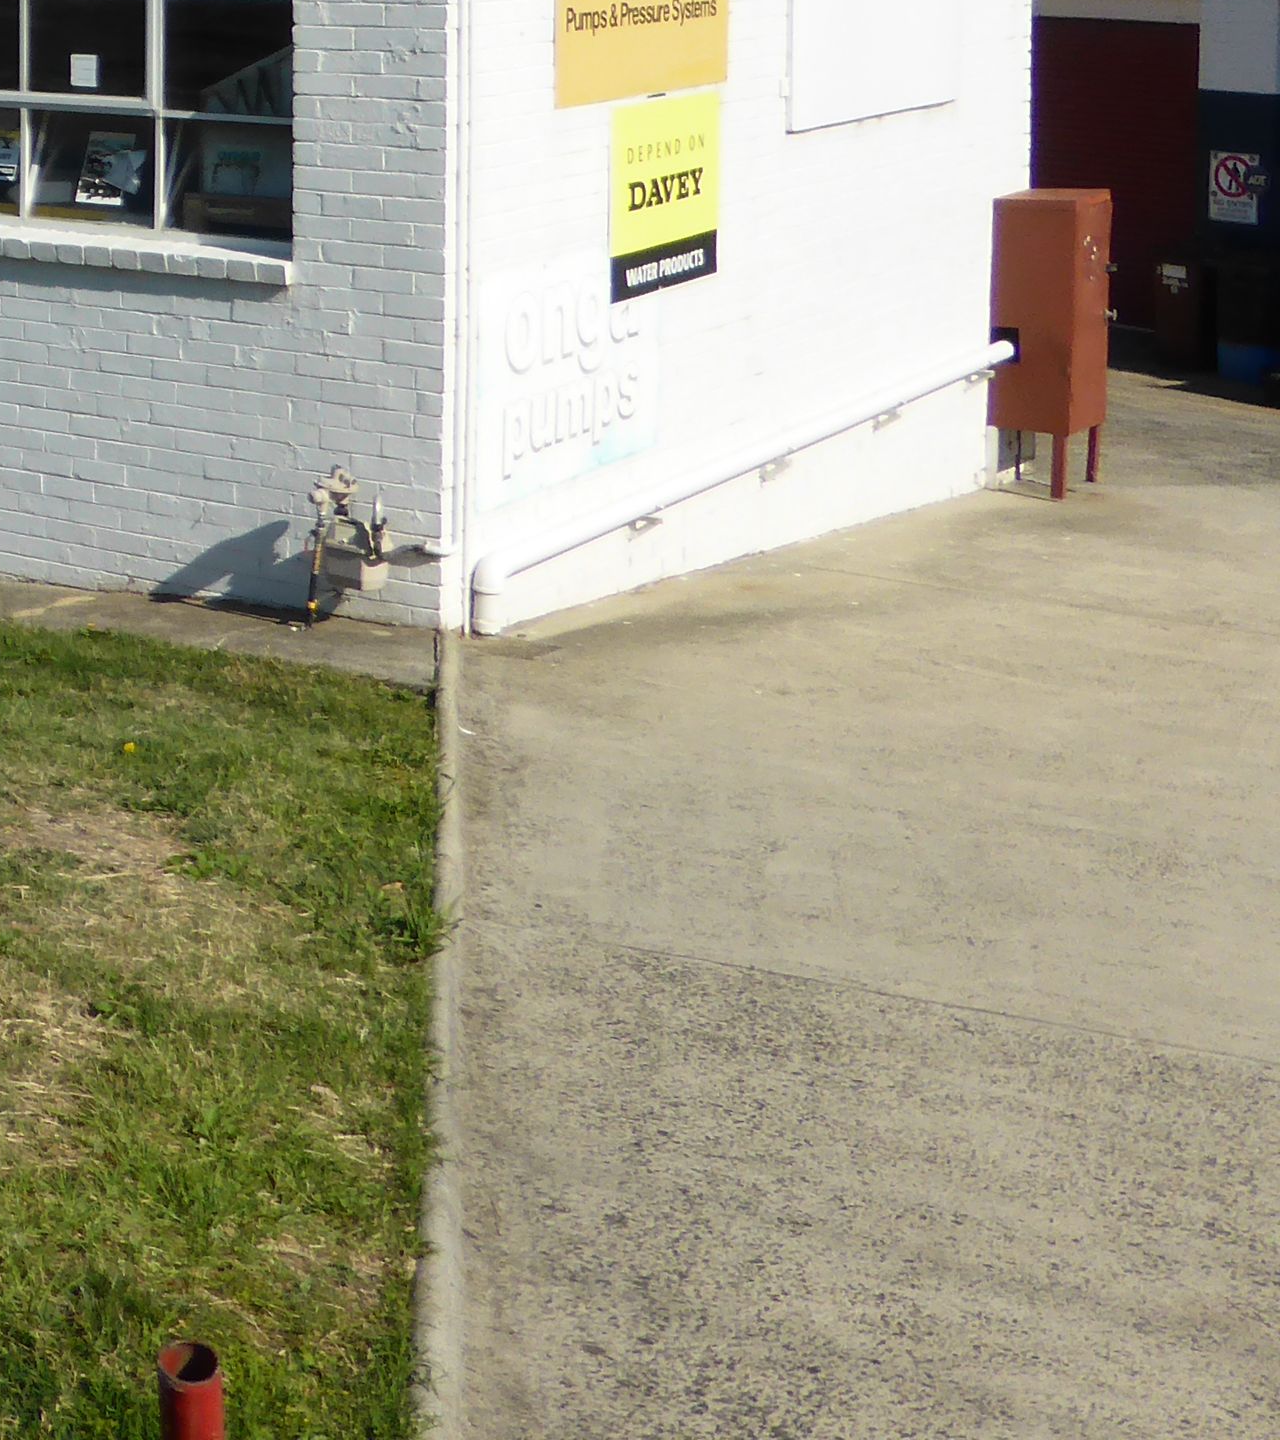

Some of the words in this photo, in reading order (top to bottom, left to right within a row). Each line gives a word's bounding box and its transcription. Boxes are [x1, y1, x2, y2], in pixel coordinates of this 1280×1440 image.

[566, 7, 607, 36] Pumps
[609, 3, 618, 27] &
[620, 2, 669, 26] Pressure
[627, 138, 681, 164] DEPEND
[689, 134, 705, 151] ON
[628, 166, 703, 211] DAVEY
[626, 262, 658, 287] WATER
[659, 248, 704, 277] PRODUCTS
[502, 360, 639, 481] pumps
